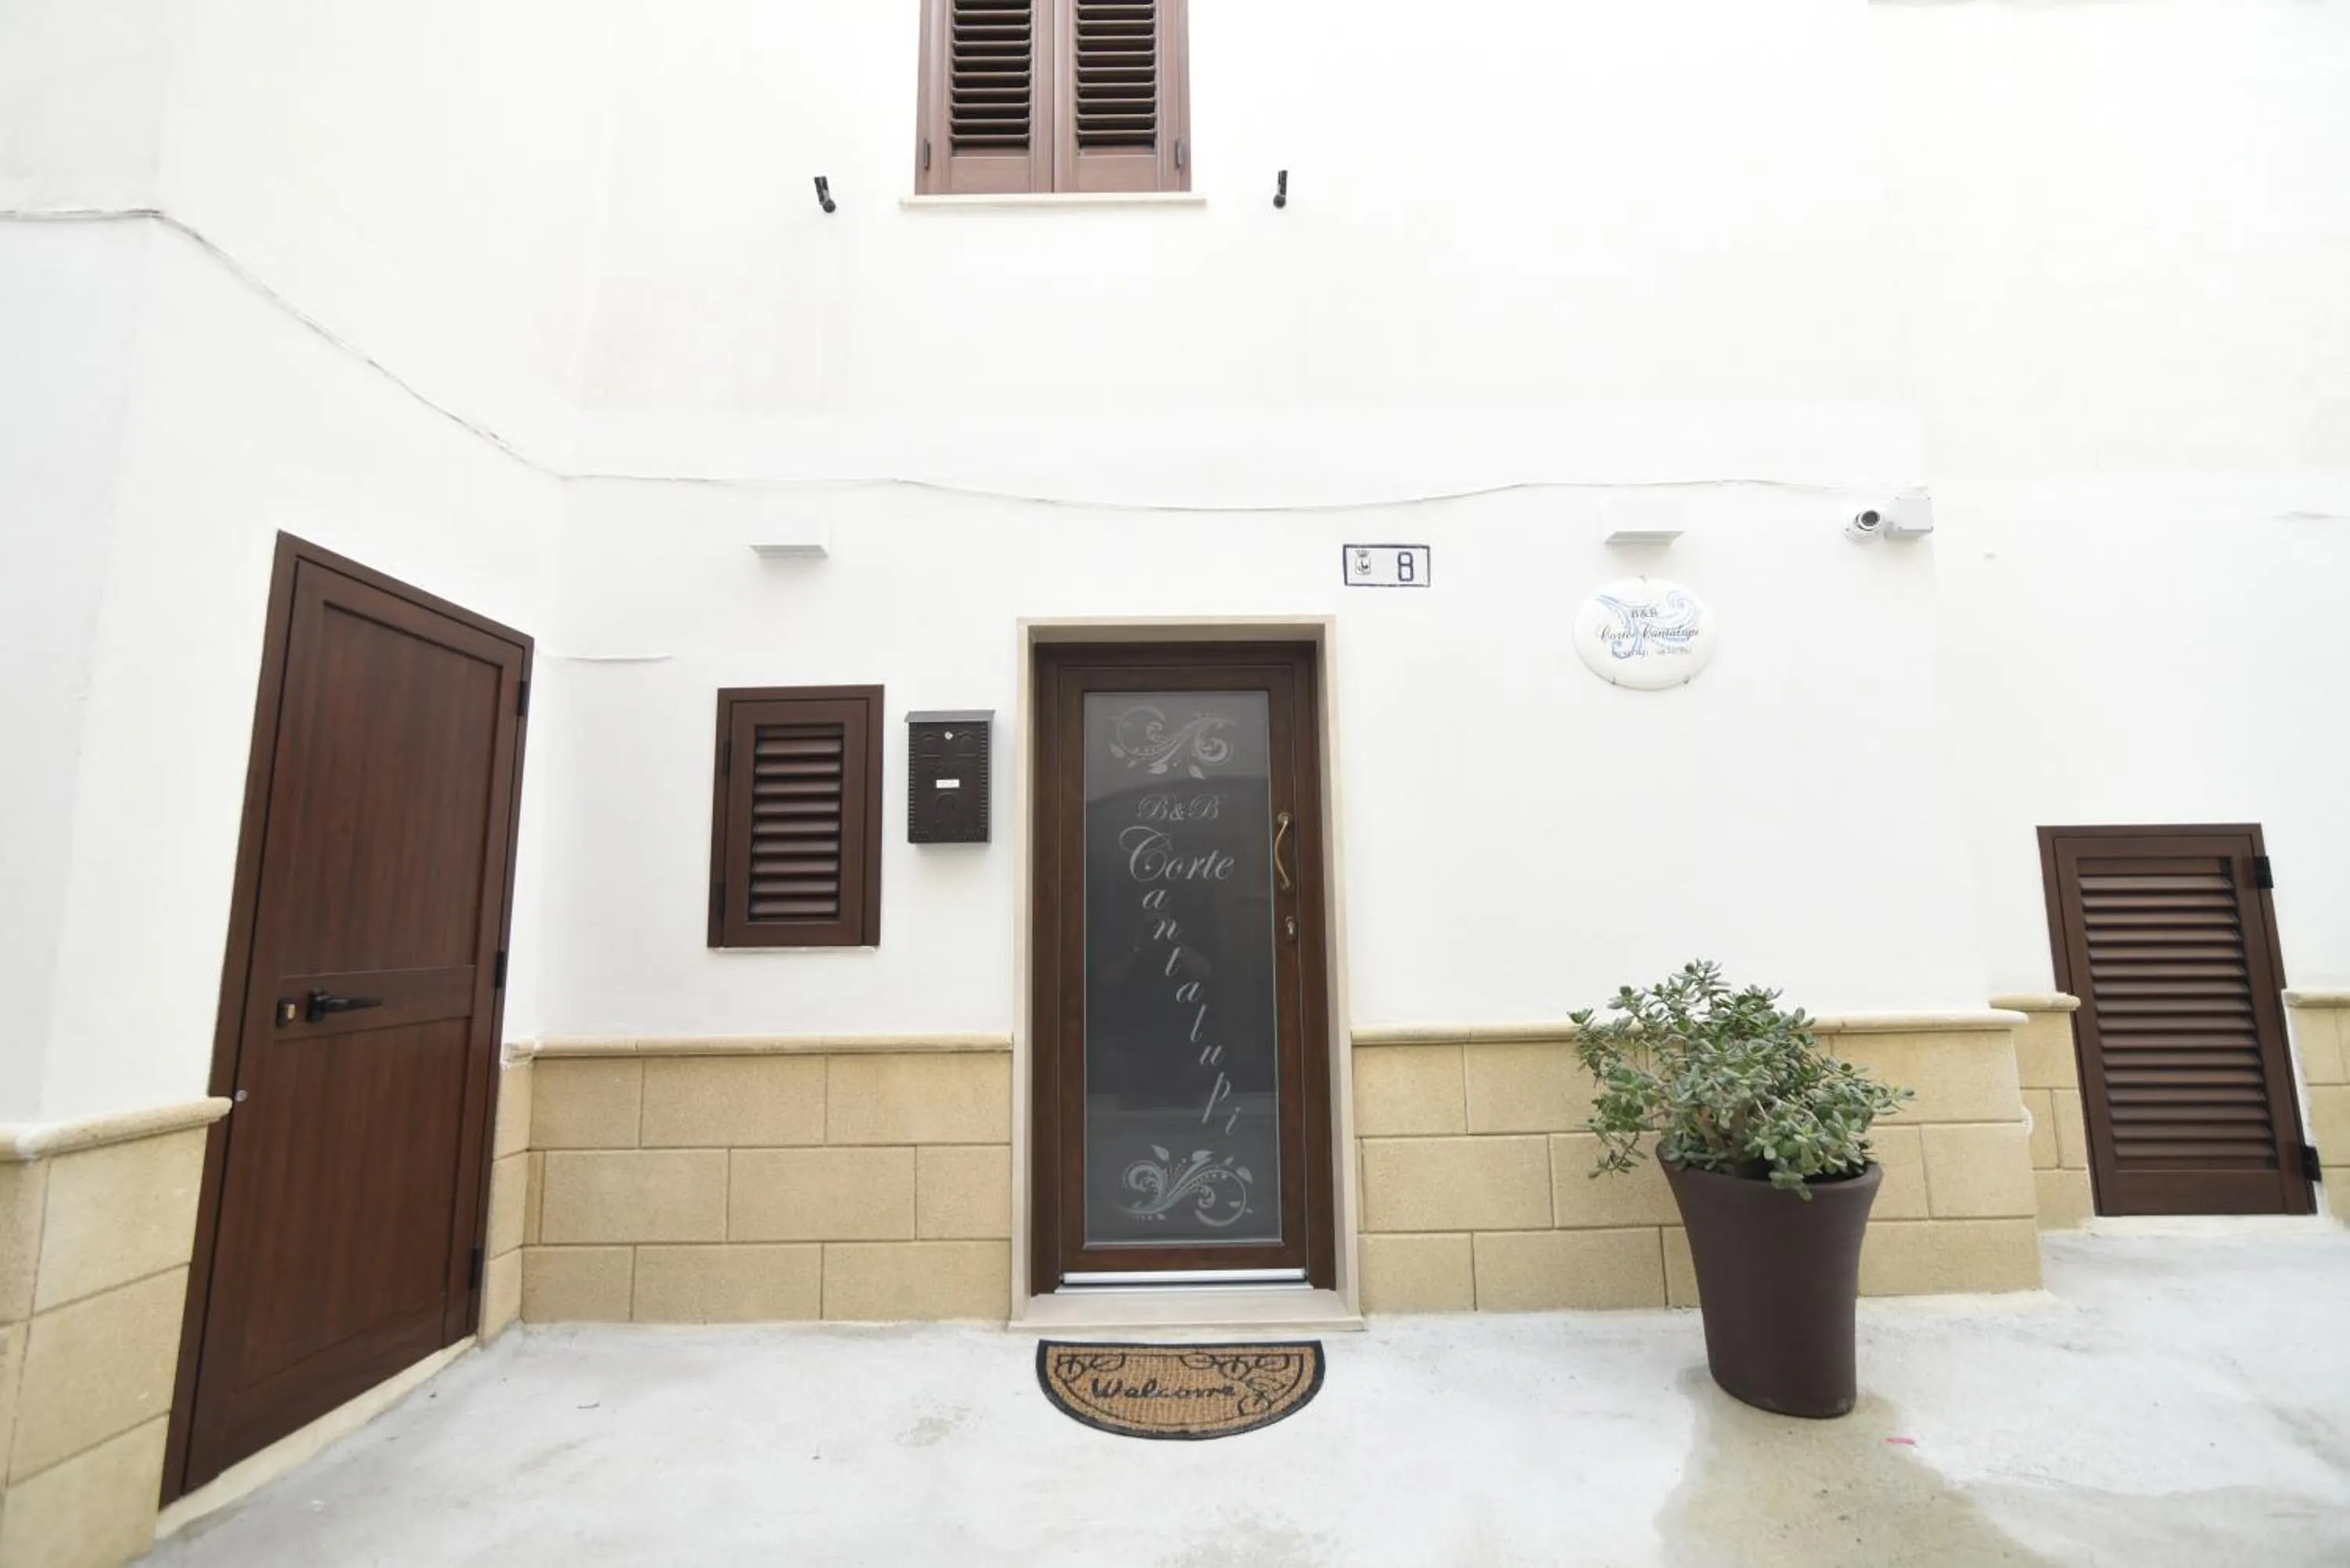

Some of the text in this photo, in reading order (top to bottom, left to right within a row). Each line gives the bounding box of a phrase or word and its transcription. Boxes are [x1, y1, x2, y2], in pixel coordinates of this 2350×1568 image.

[1397, 551, 1414, 582] 8
[1137, 793, 1220, 821] B&B
[1119, 825, 1235, 882] Corte
